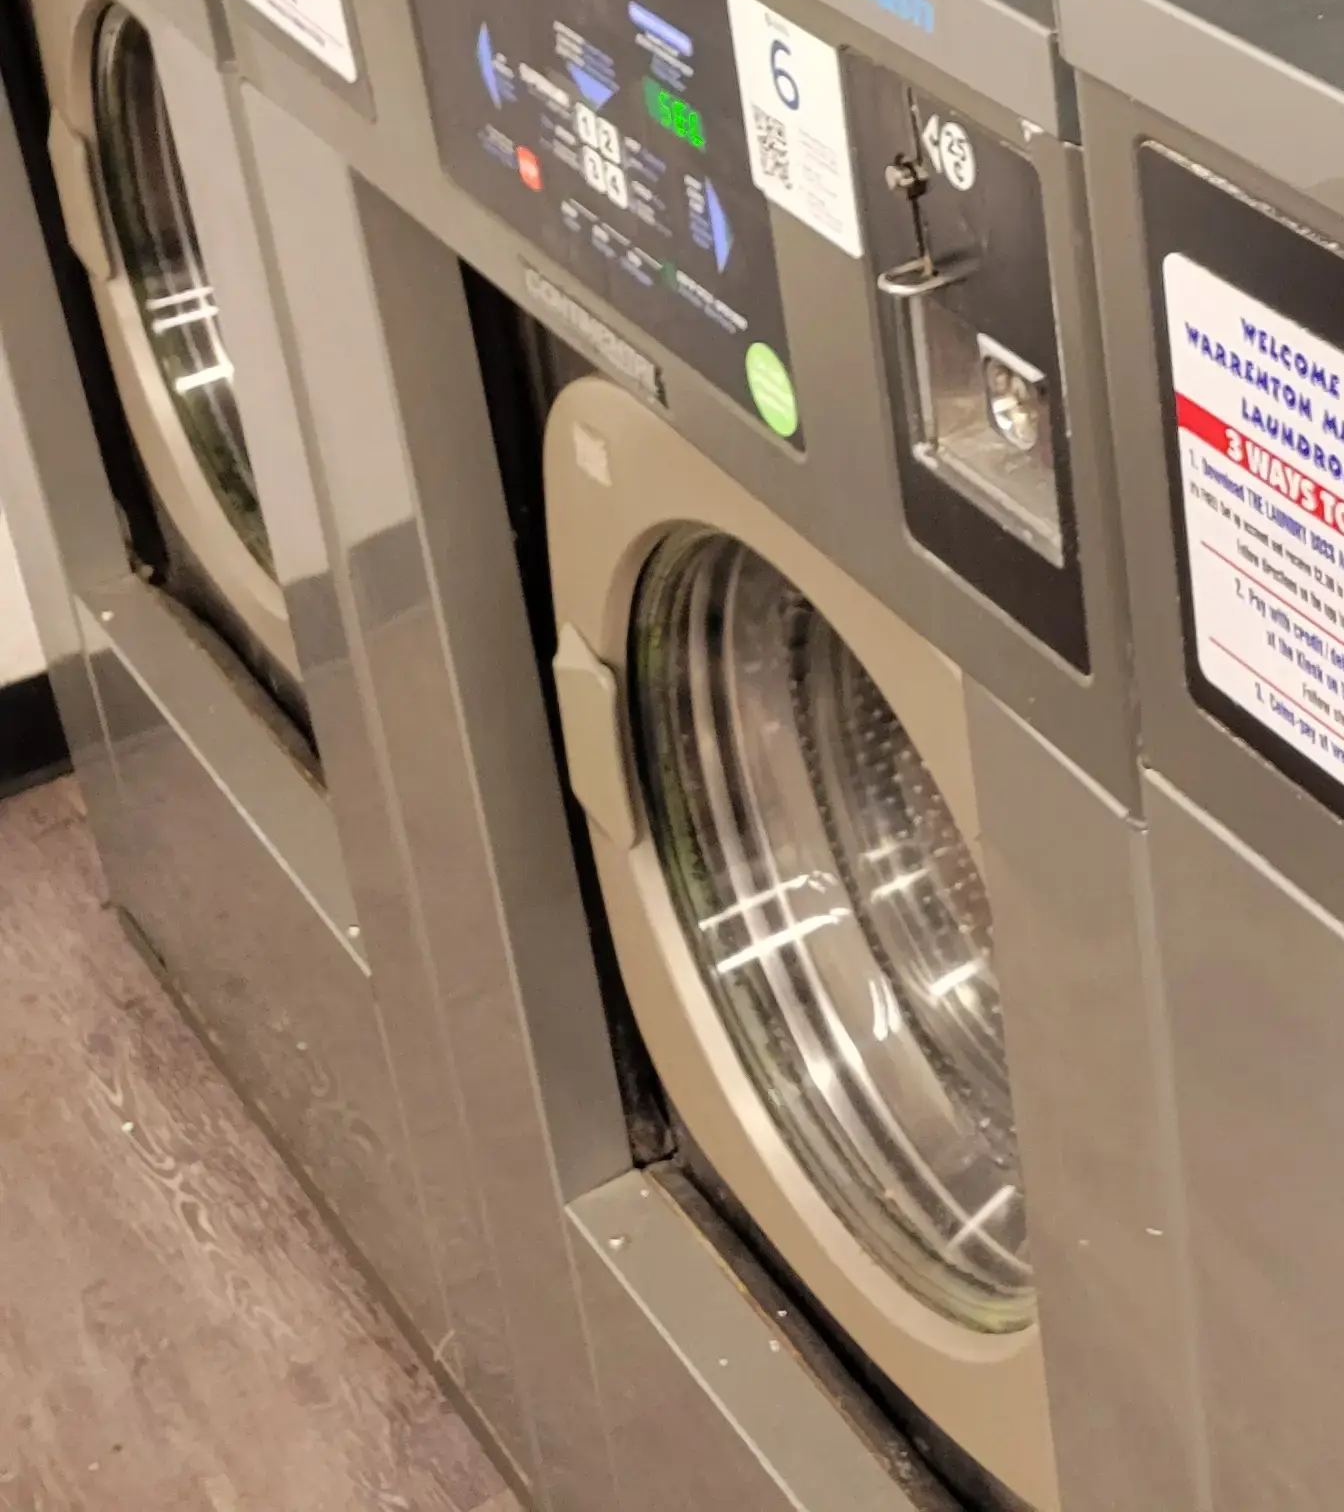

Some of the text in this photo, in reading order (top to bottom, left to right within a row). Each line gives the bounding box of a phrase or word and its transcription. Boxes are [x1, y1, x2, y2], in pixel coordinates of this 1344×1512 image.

[769, 39, 800, 111] 6
[1185, 321, 1312, 421] WARRENTON
[1240, 317, 1340, 399] WELCOME
[1224, 428, 1244, 463] 3
[1245, 440, 1319, 513] WAYS
[1249, 588, 1266, 618] Pay
